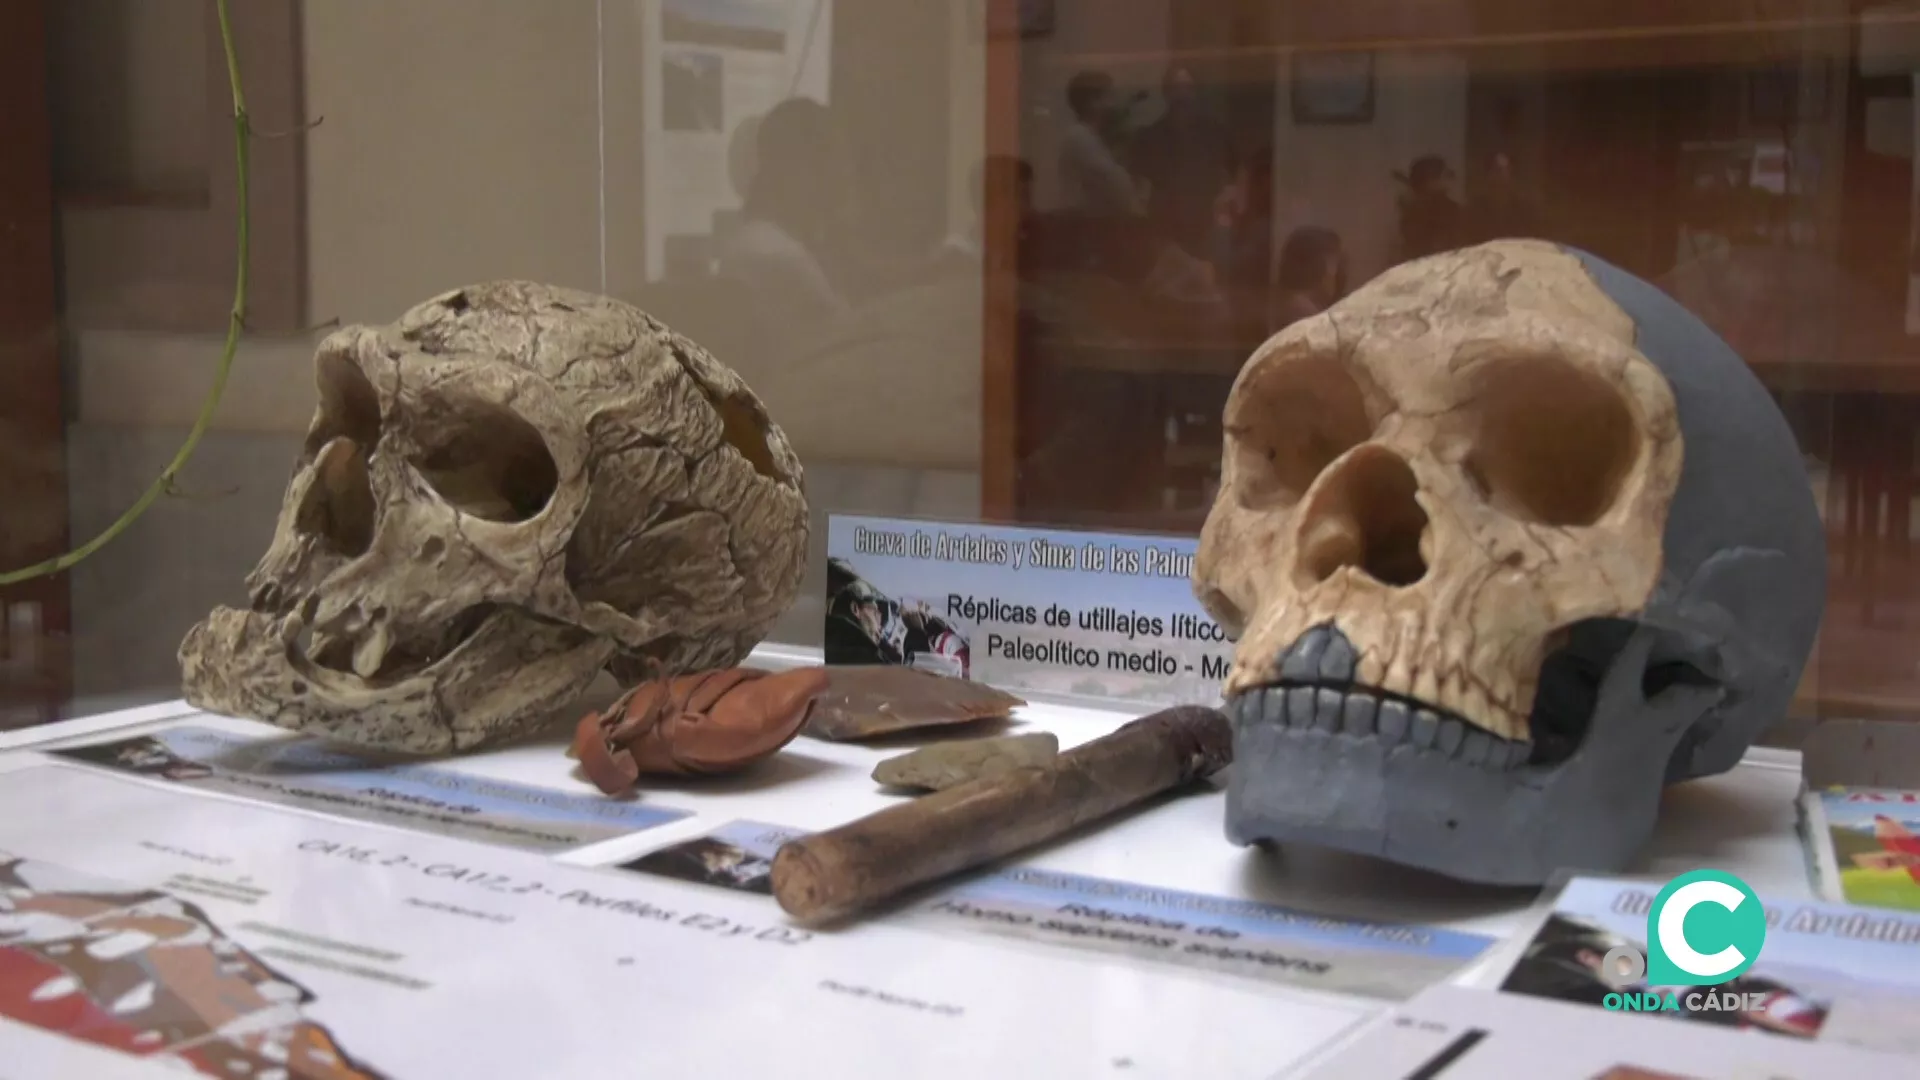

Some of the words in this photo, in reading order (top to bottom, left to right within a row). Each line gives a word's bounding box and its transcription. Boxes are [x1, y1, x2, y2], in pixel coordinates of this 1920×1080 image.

[855, 525, 906, 557] Cueva
[910, 529, 931, 559] de
[936, 530, 1007, 565] Ardales
[1012, 540, 1025, 570] y
[1029, 537, 1076, 572] Sima
[1081, 541, 1105, 573] de
[1109, 543, 1139, 576] las
[947, 593, 1036, 626] Réplicas
[1044, 602, 1071, 628] de
[1078, 606, 1163, 640] utillajes
[988, 633, 1100, 668] Paleolítico
[1107, 649, 1177, 675] medio
[1194, 924, 1241, 940] de
